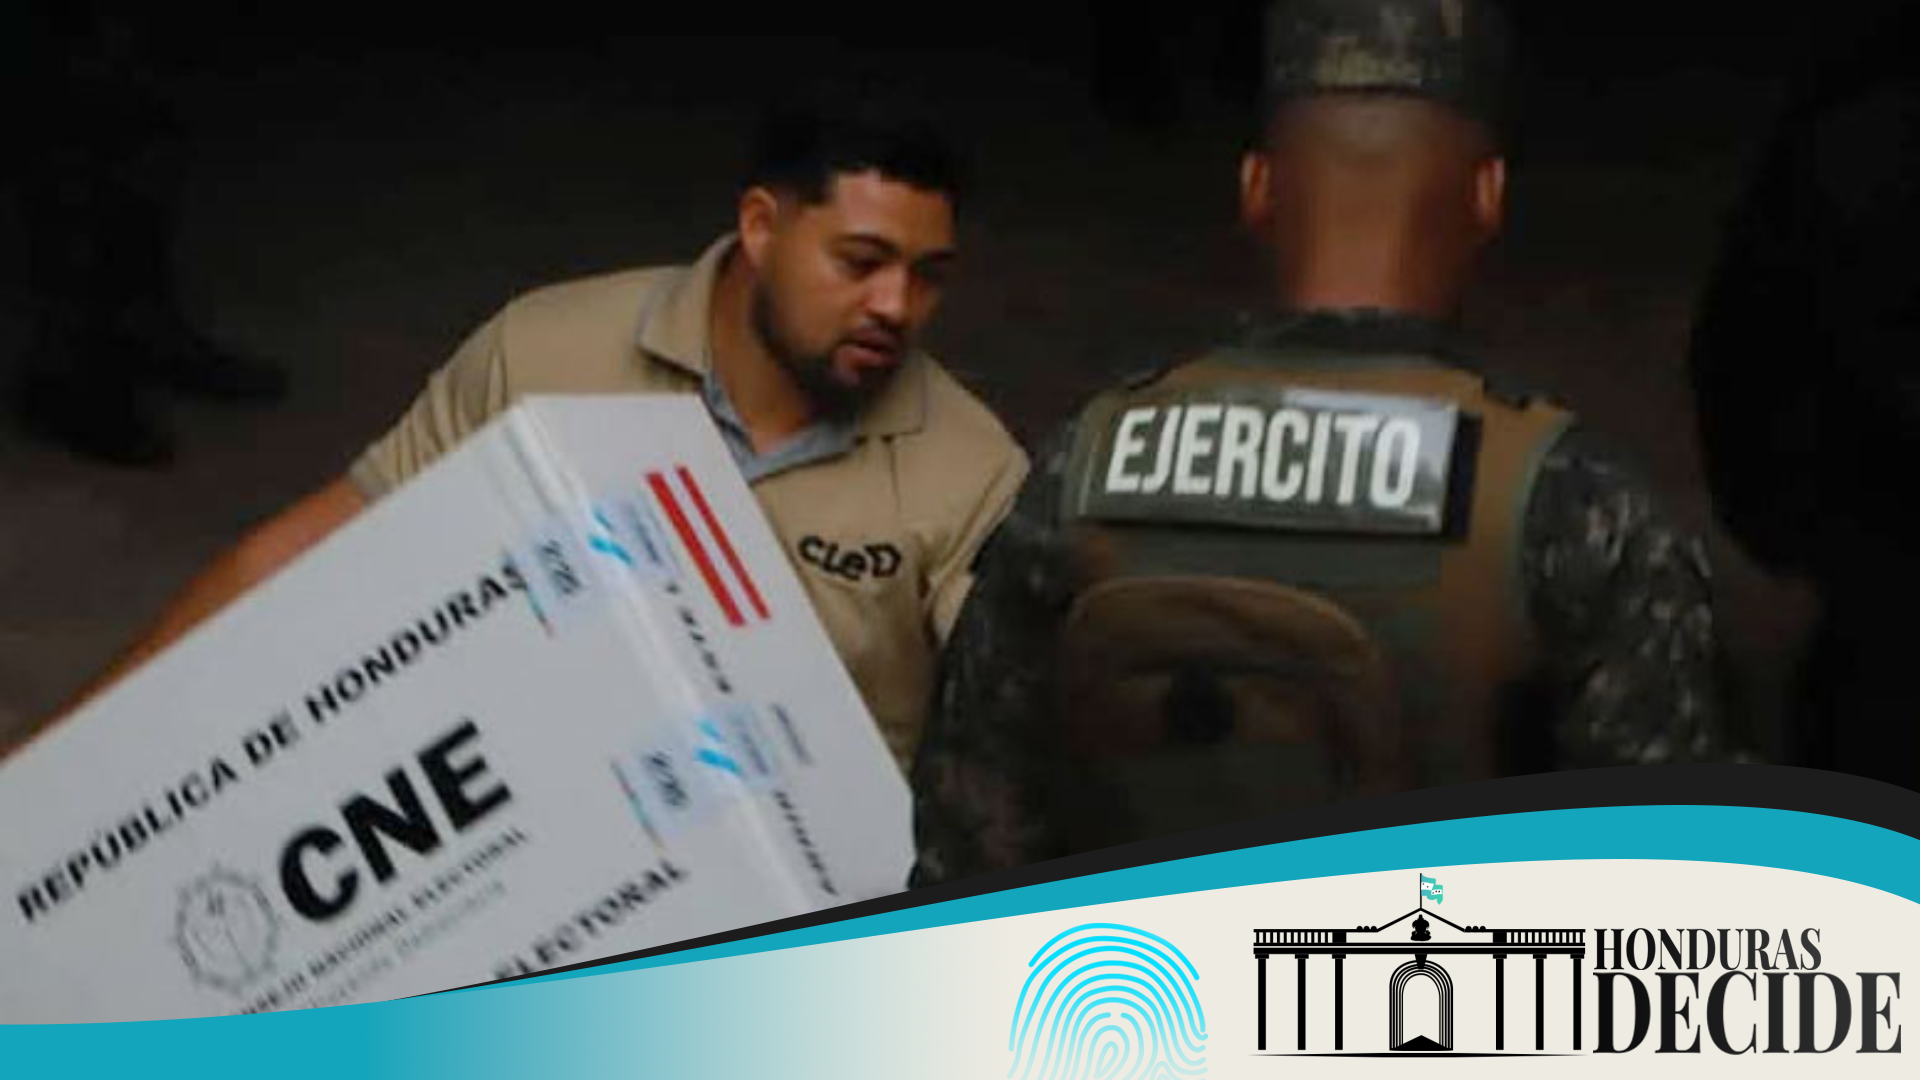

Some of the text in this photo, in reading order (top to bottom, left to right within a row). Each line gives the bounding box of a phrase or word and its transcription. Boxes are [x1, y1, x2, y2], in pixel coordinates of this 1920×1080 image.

[1104, 404, 1422, 508] EJERCITO
[244, 709, 300, 768] DE
[304, 562, 528, 724] HONDURAS
[277, 718, 514, 922] CNE
